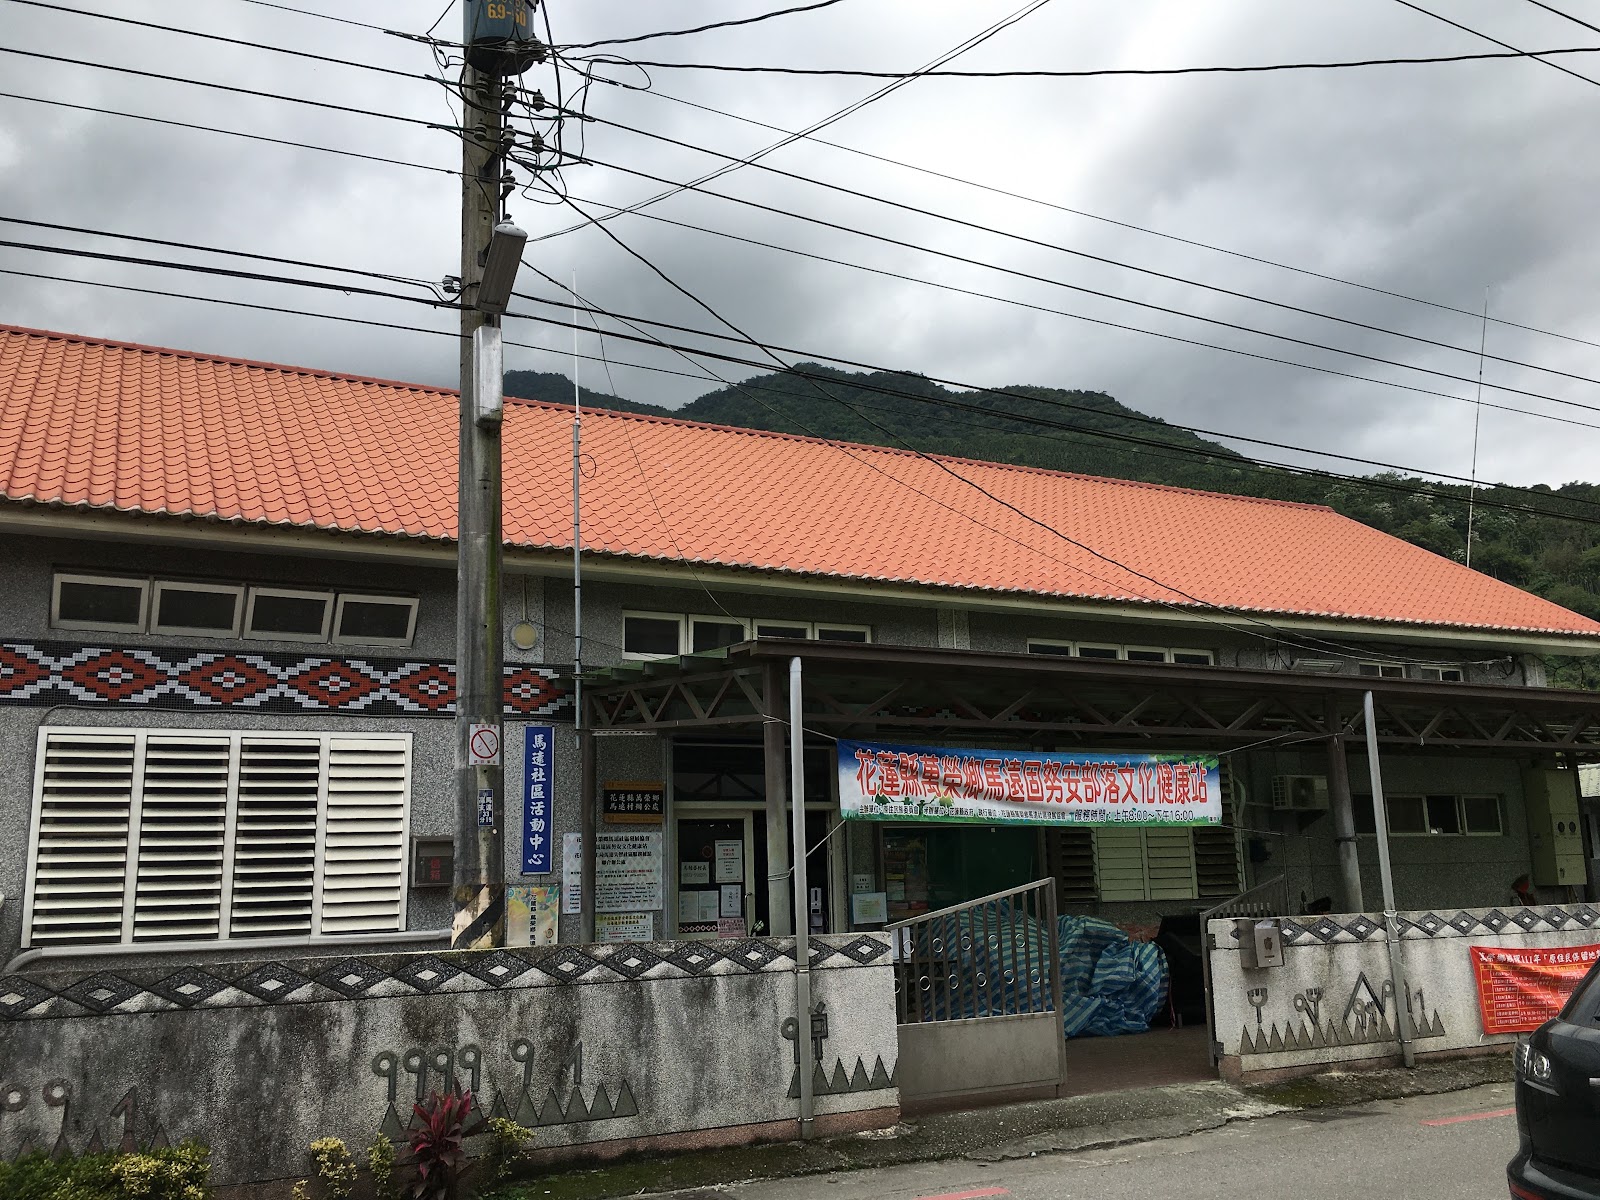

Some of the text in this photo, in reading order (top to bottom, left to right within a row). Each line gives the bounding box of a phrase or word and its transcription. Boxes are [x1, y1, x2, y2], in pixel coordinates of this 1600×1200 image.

[527, 733, 547, 866] 馬遠社區活動中心
[855, 749, 1208, 805] 花蓮縣萬榮鄉馬遠固努安部落文化健康站
